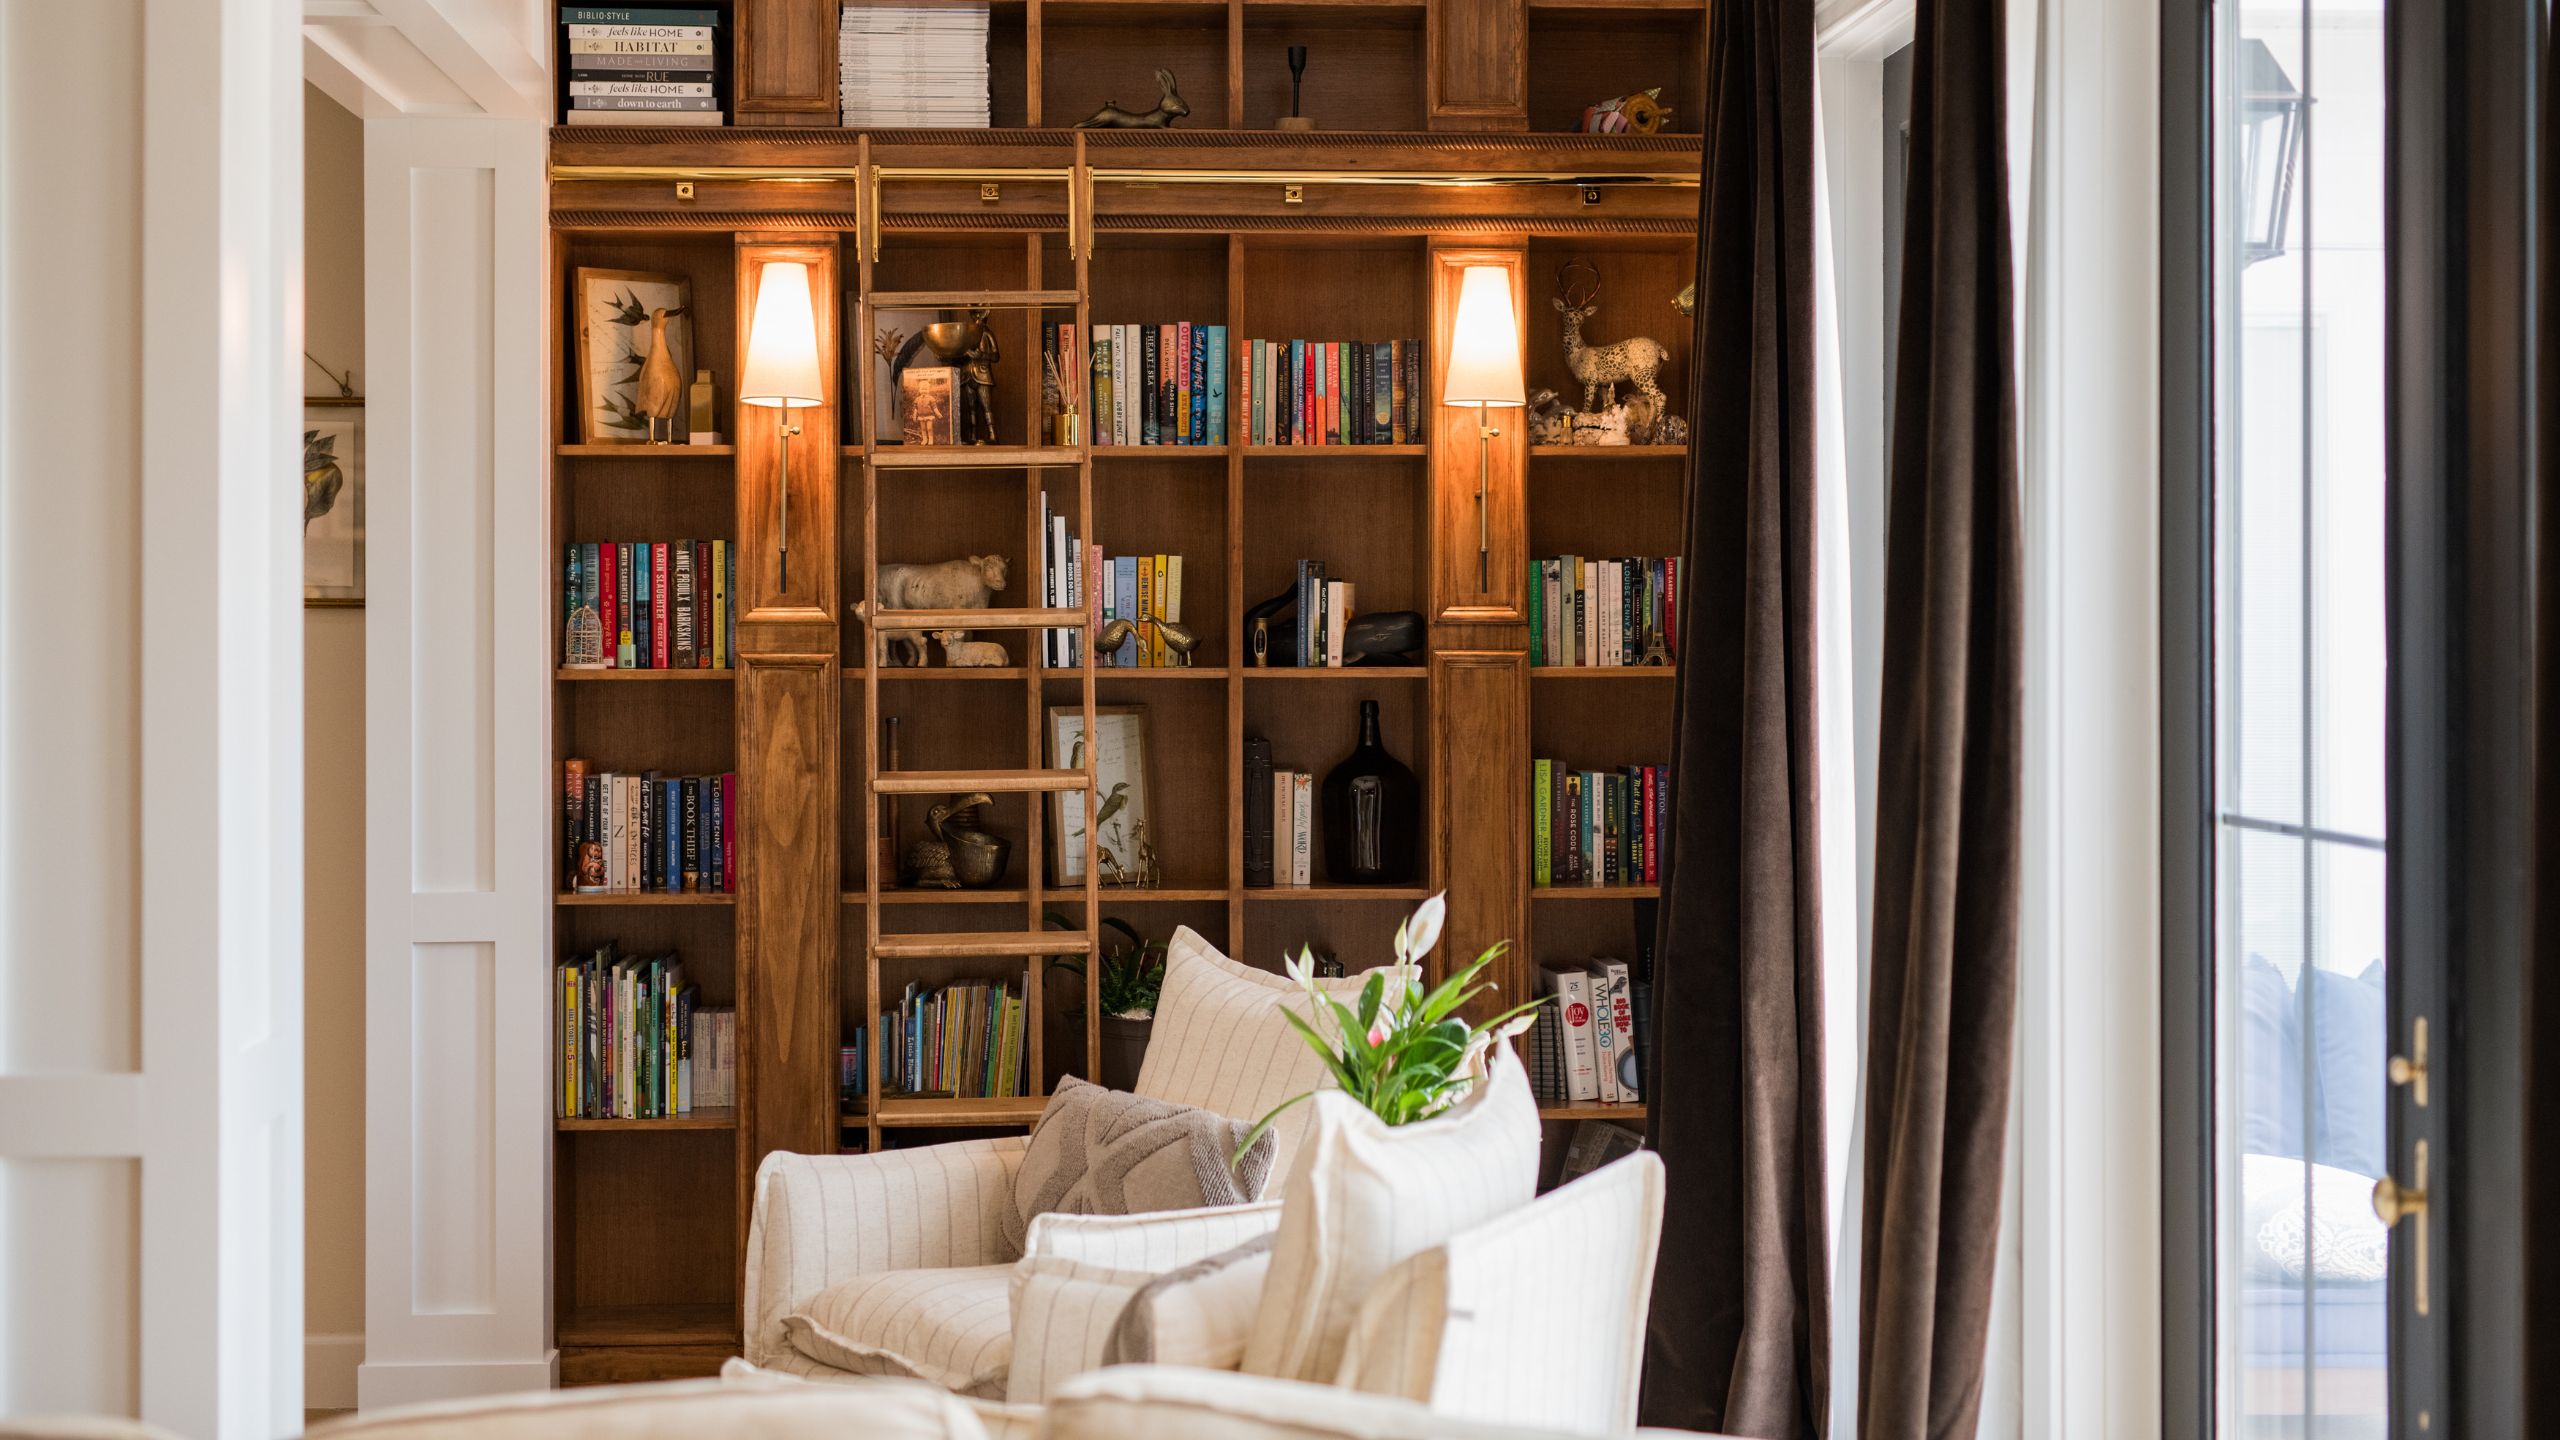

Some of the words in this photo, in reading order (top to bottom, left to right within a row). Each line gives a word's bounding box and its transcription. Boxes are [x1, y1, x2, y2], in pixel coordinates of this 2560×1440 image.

[607, 27, 629, 38] feels
[630, 27, 648, 36] like
[650, 28, 683, 38] HOME
[615, 42, 678, 52] HABITAT
[597, 57, 632, 66] MADE
[645, 58, 688, 66] LIVING
[646, 72, 669, 82] RUE
[608, 84, 630, 95] feels
[631, 84, 648, 92] like
[650, 86, 684, 94] HOME
[618, 99, 643, 108] down
[656, 99, 682, 108] earth
[1180, 326, 1188, 387] OUTLAWED
[656, 548, 664, 572] KARIN
[676, 550, 690, 572] ANNIE
[569, 572, 576, 581] Ng
[656, 574, 664, 619] SLAUGHTER
[677, 574, 690, 602] PROULX
[677, 607, 692, 650] BARKSKINS
[606, 638, 611, 648] Me
[1634, 778, 1642, 797] Matt
[686, 796, 695, 826] BOOK
[1296, 800, 1309, 828] beautiful
[1539, 787, 1547, 832] GARDNER
[1632, 800, 1641, 816] Haig
[687, 828, 696, 860] THIEF
[1296, 831, 1307, 854] WORD
[1594, 983, 1612, 1048] WHOLE30
